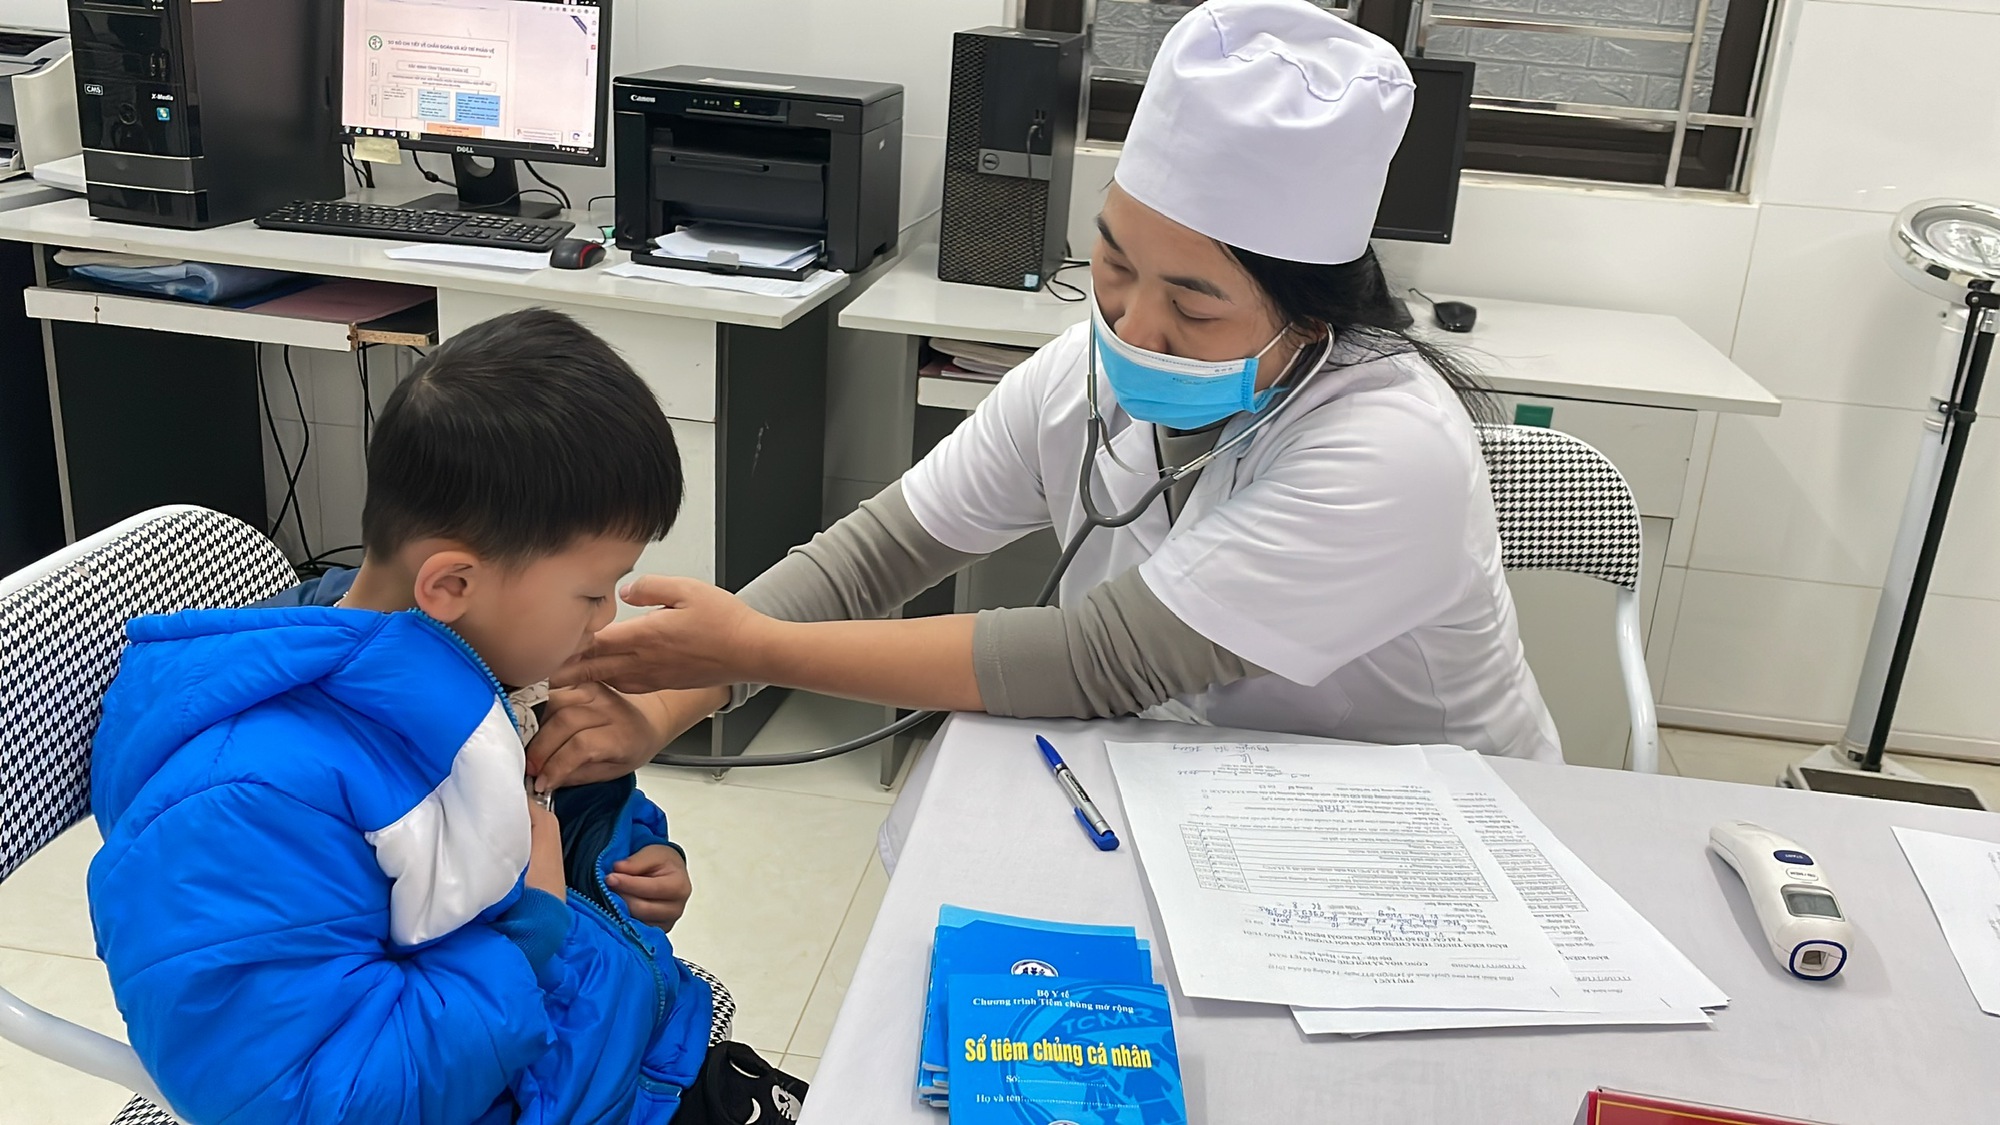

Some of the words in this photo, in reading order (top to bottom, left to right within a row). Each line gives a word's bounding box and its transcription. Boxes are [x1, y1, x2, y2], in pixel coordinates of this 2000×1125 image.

[86, 86, 101, 94] CMS
[151, 93, 174, 101] X-Media
[630, 94, 656, 103] Canon
[456, 146, 475, 154] DELL
[1036, 989, 1049, 999] Bộ
[1051, 990, 1061, 998] Y
[1061, 989, 1069, 998] tế
[972, 997, 1011, 1008] Chương
[1013, 997, 1037, 1006] trình
[1040, 997, 1062, 1007] Tiêm
[1065, 1000, 1093, 1011] chủng
[1095, 1002, 1110, 1010] mở
[1112, 1003, 1134, 1014] rộng
[1061, 1008, 1159, 1034] TCMR
[964, 1034, 987, 1062] Sổ
[990, 1038, 1028, 1062] tiêm
[1033, 1036, 1083, 1066] chủng
[1087, 1041, 1108, 1065] cá
[1111, 1044, 1152, 1068] nhân
[976, 1093, 991, 1105] Họ
[993, 1094, 1004, 1103] và
[1006, 1093, 1023, 1103] tên:
